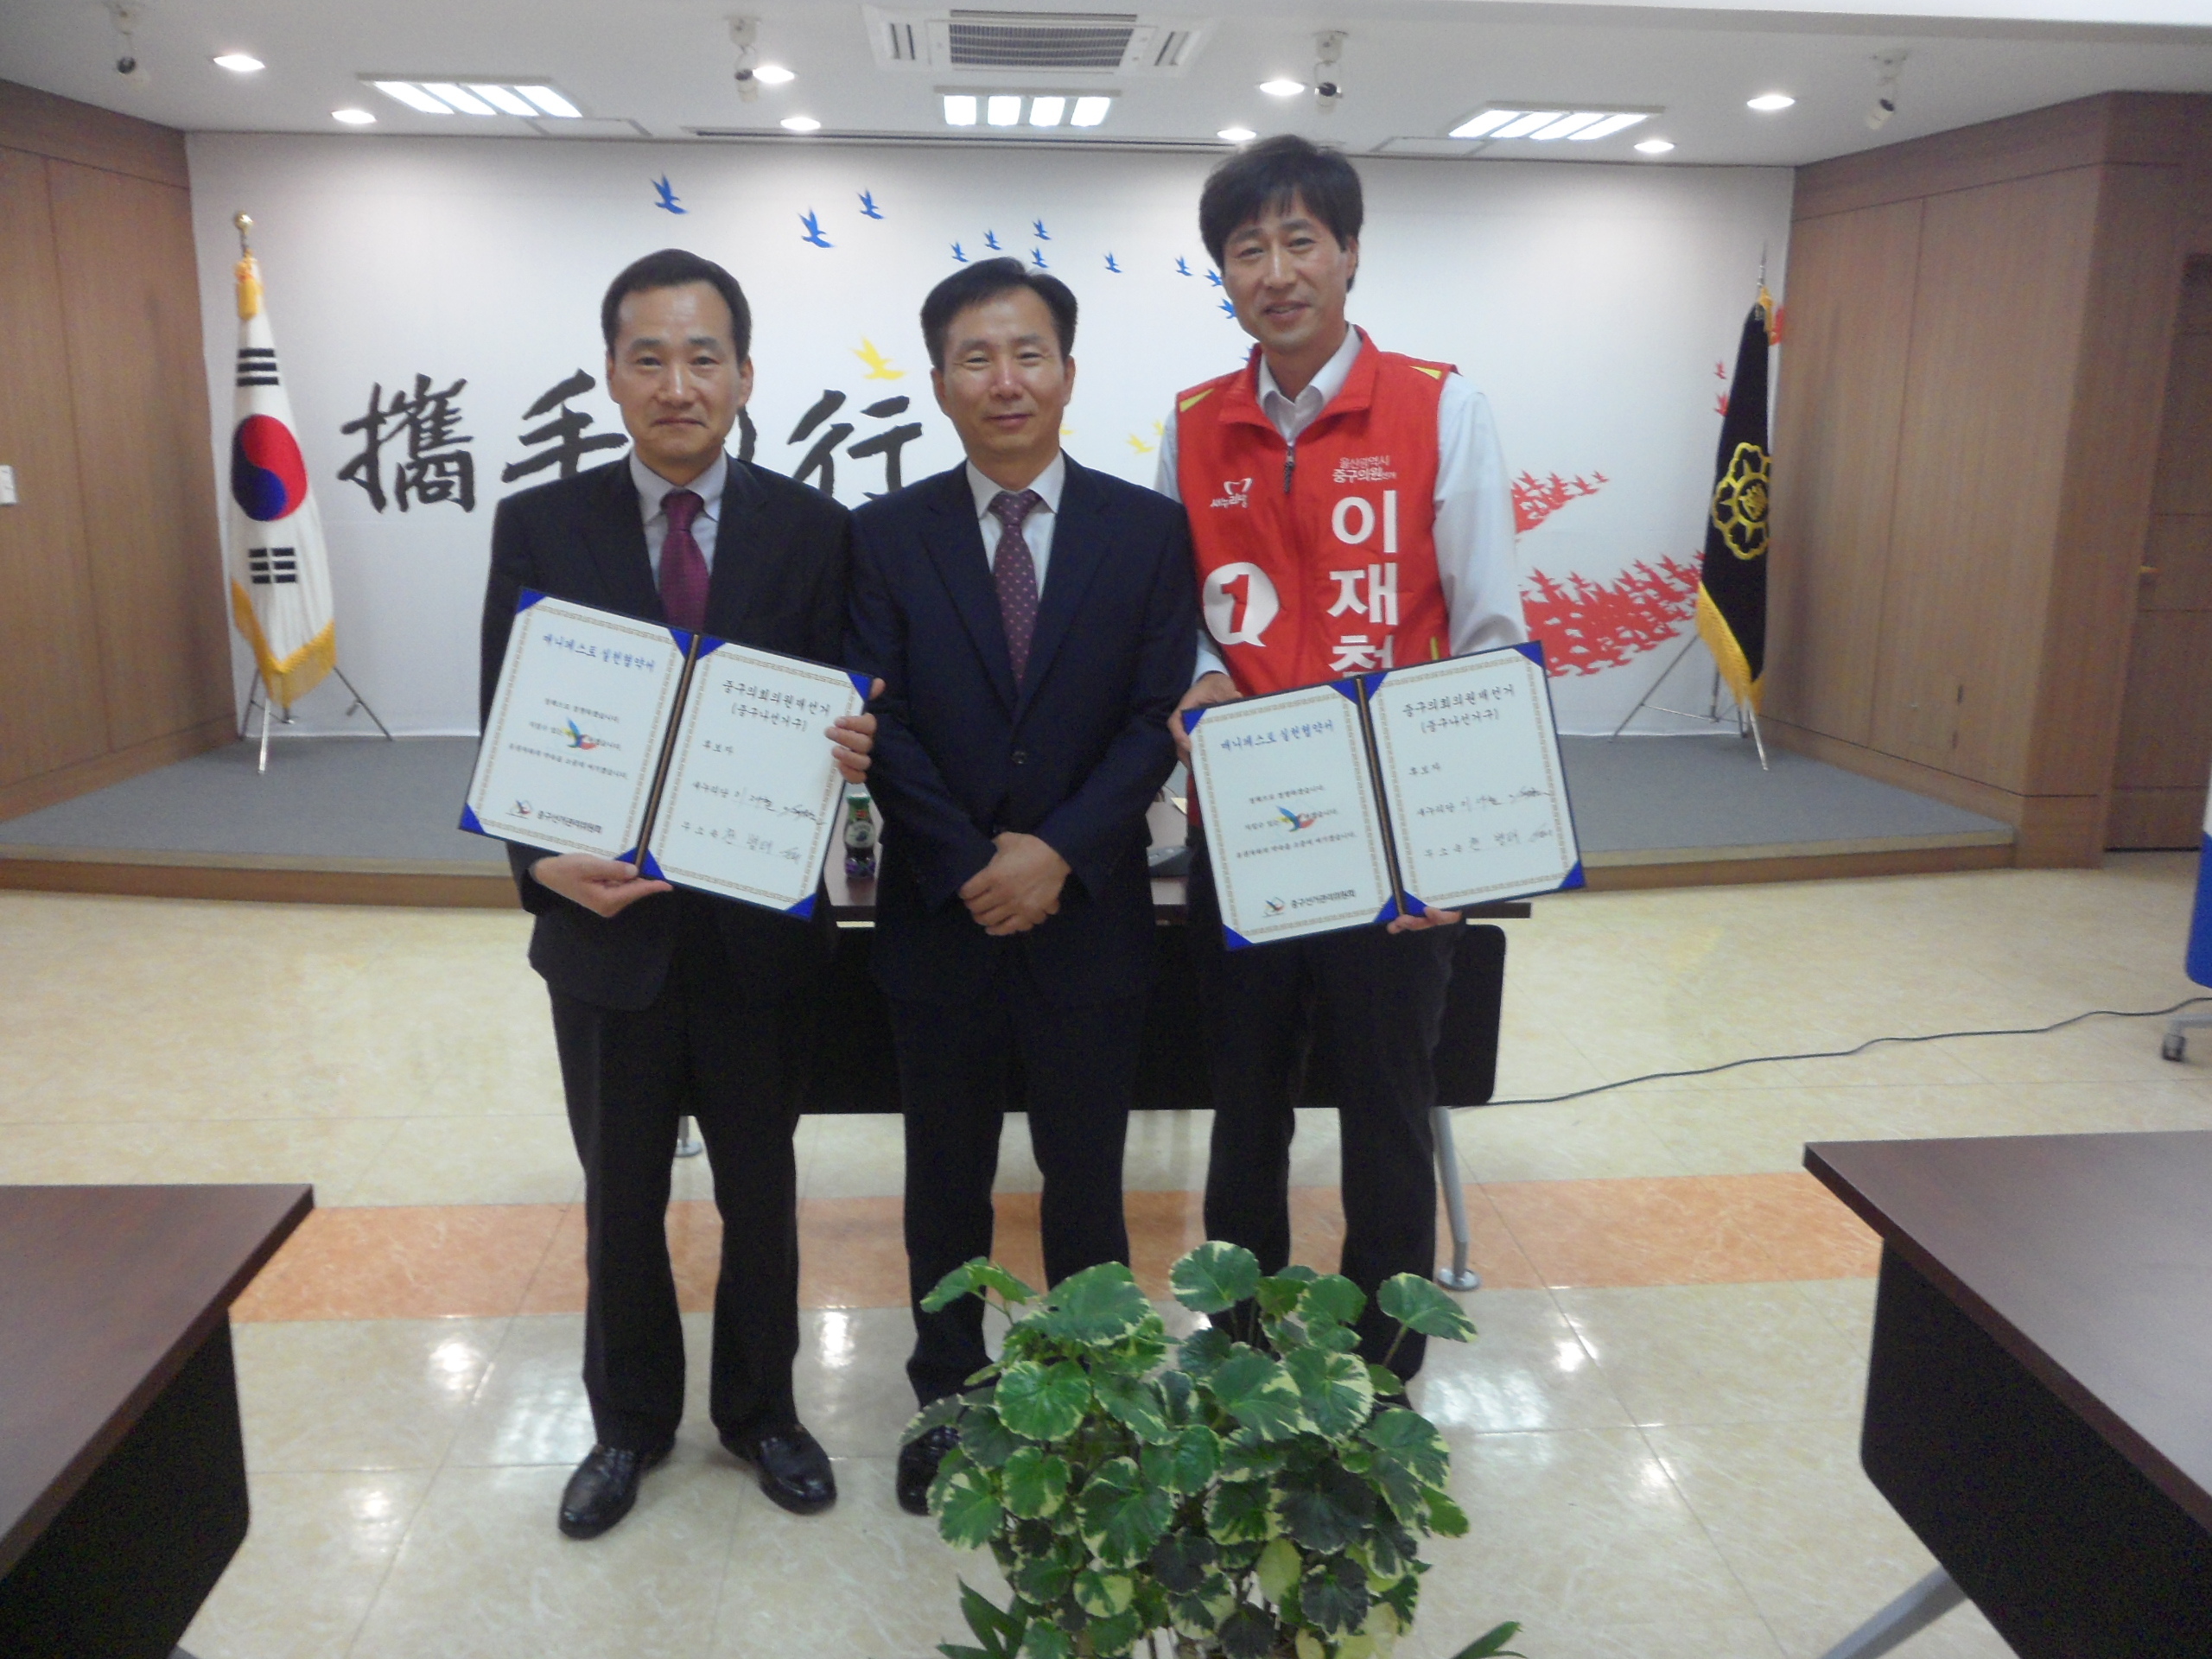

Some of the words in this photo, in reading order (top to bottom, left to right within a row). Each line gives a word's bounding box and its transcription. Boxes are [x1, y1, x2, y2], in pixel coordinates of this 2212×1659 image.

[338, 368, 924, 513] 攜手行
[1220, 574, 1249, 634] 1
